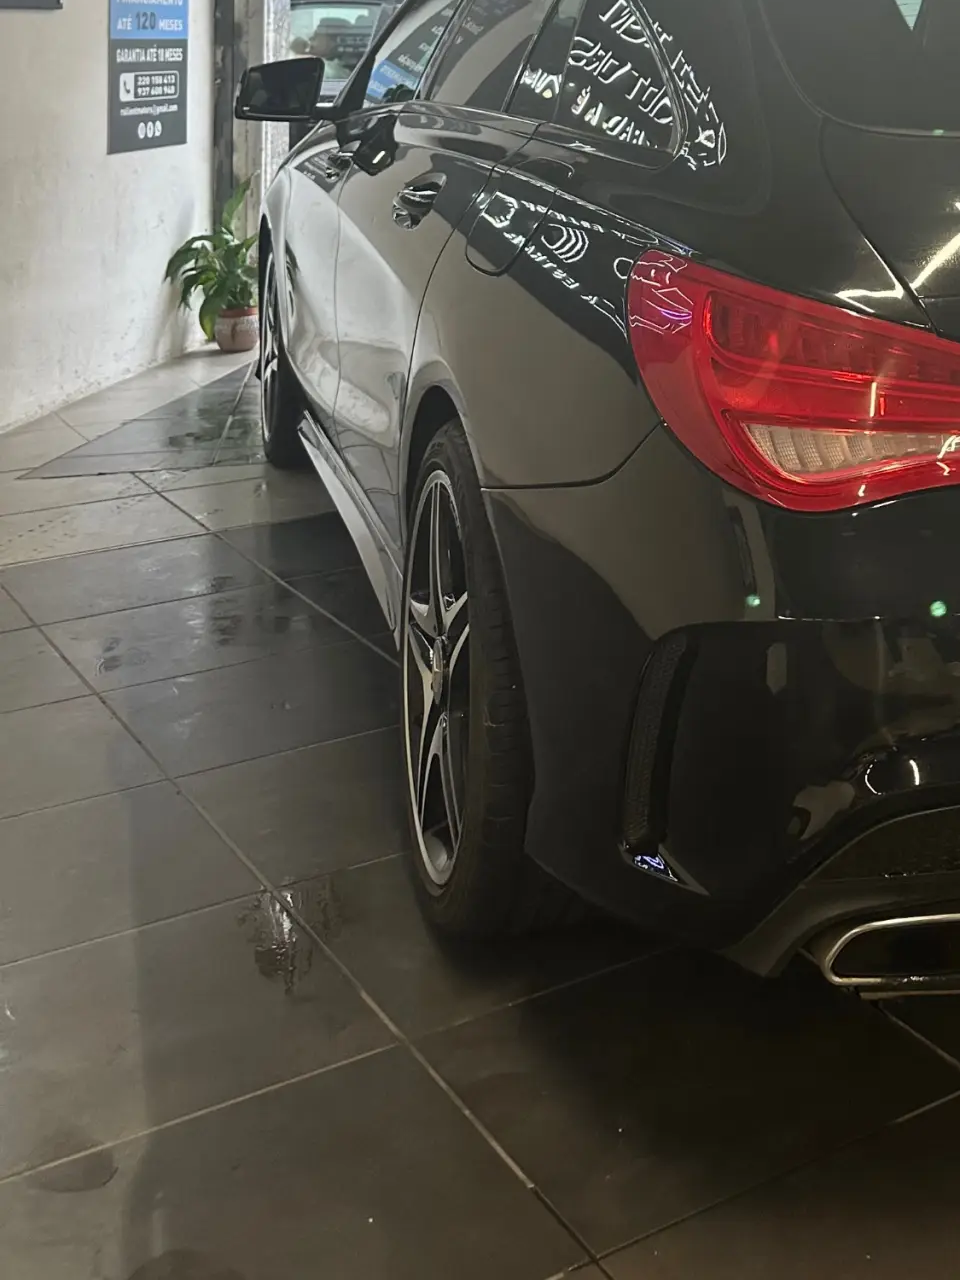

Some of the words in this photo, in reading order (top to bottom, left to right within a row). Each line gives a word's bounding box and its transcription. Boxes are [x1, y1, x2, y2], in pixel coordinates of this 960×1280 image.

[117, 14, 133, 31] ATÉ
[135, 11, 157, 31] 120
[159, 19, 184, 32] MESES
[116, 48, 145, 62] GARANTIA
[146, 43, 157, 62] ATÉ
[165, 47, 184, 62] MESES
